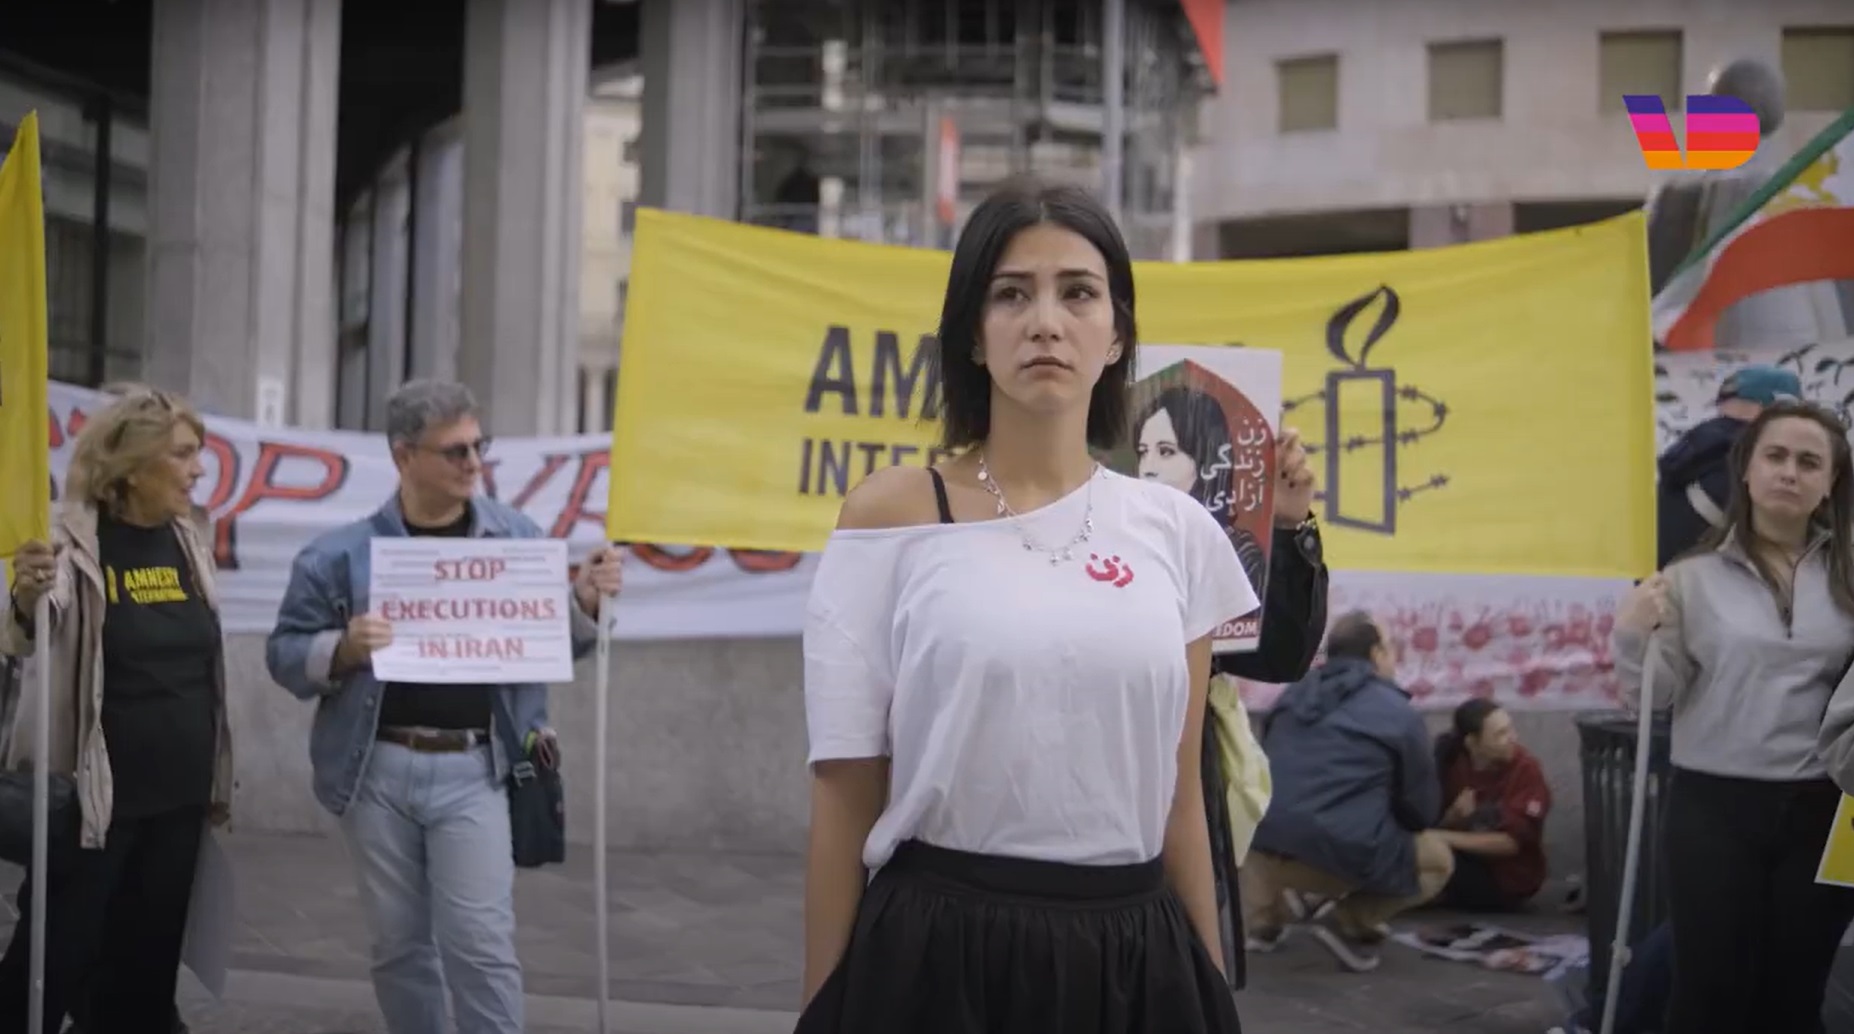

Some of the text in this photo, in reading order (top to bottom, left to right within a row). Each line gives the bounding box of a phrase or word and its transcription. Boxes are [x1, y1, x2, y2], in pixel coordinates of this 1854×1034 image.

[433, 557, 507, 581] STOP
[381, 598, 557, 621] EXECUTIONS
[418, 636, 524, 660] IN IRAN
